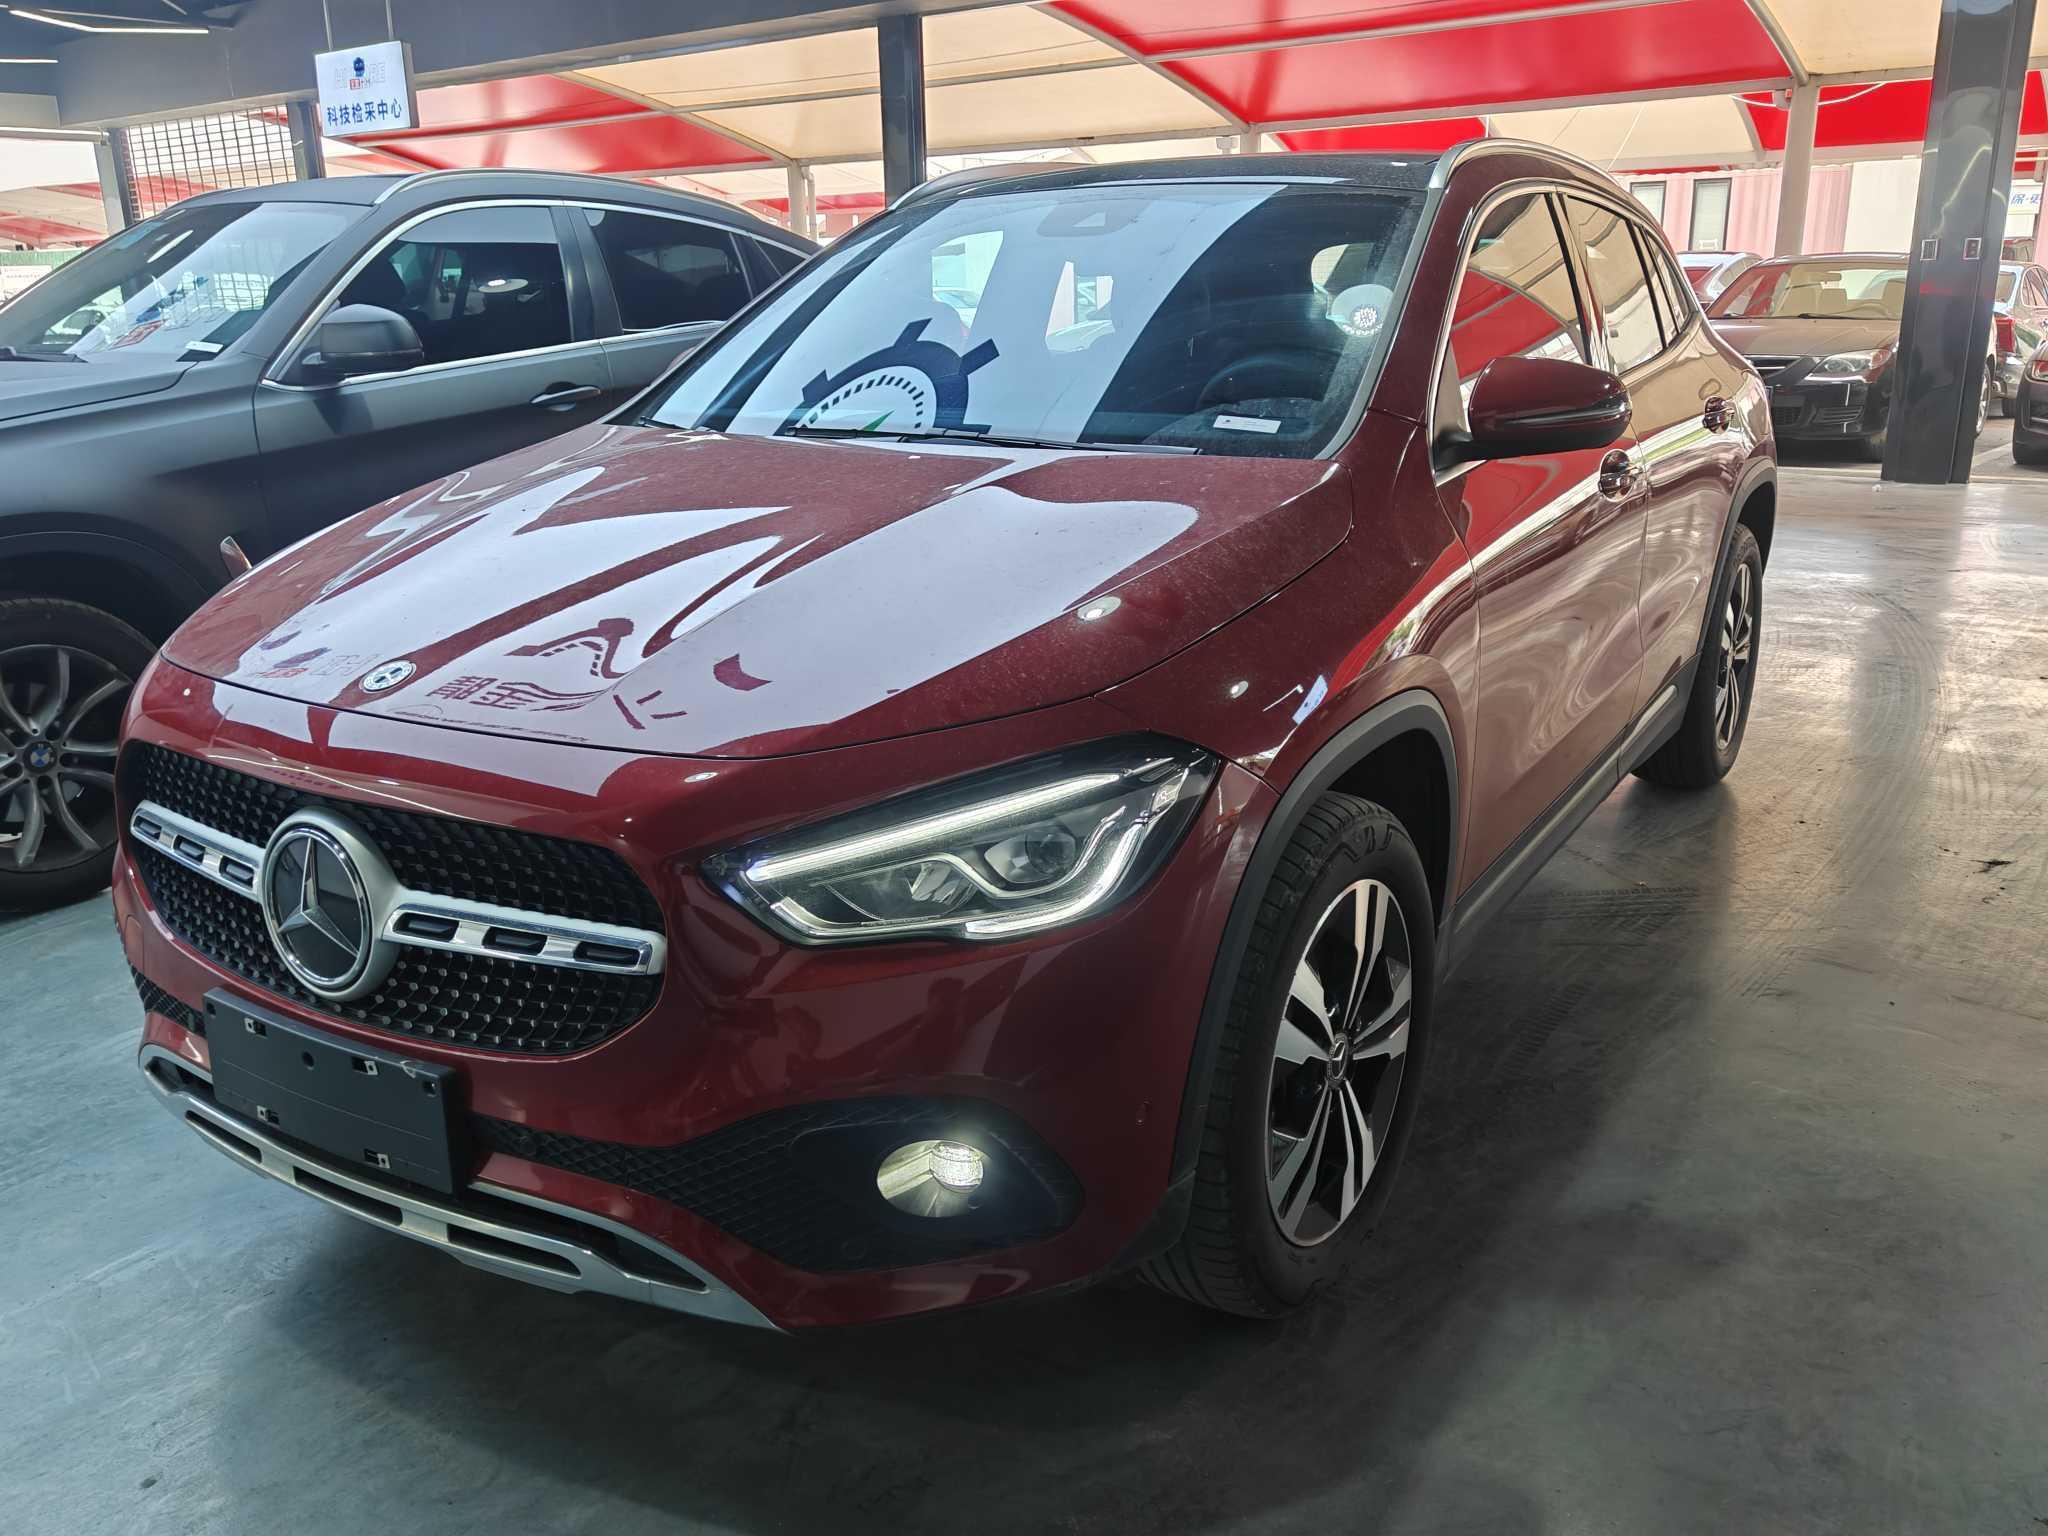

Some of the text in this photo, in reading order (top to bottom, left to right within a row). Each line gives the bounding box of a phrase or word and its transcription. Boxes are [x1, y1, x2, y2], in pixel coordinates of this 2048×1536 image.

[326, 98, 402, 127] 科技检采中心
